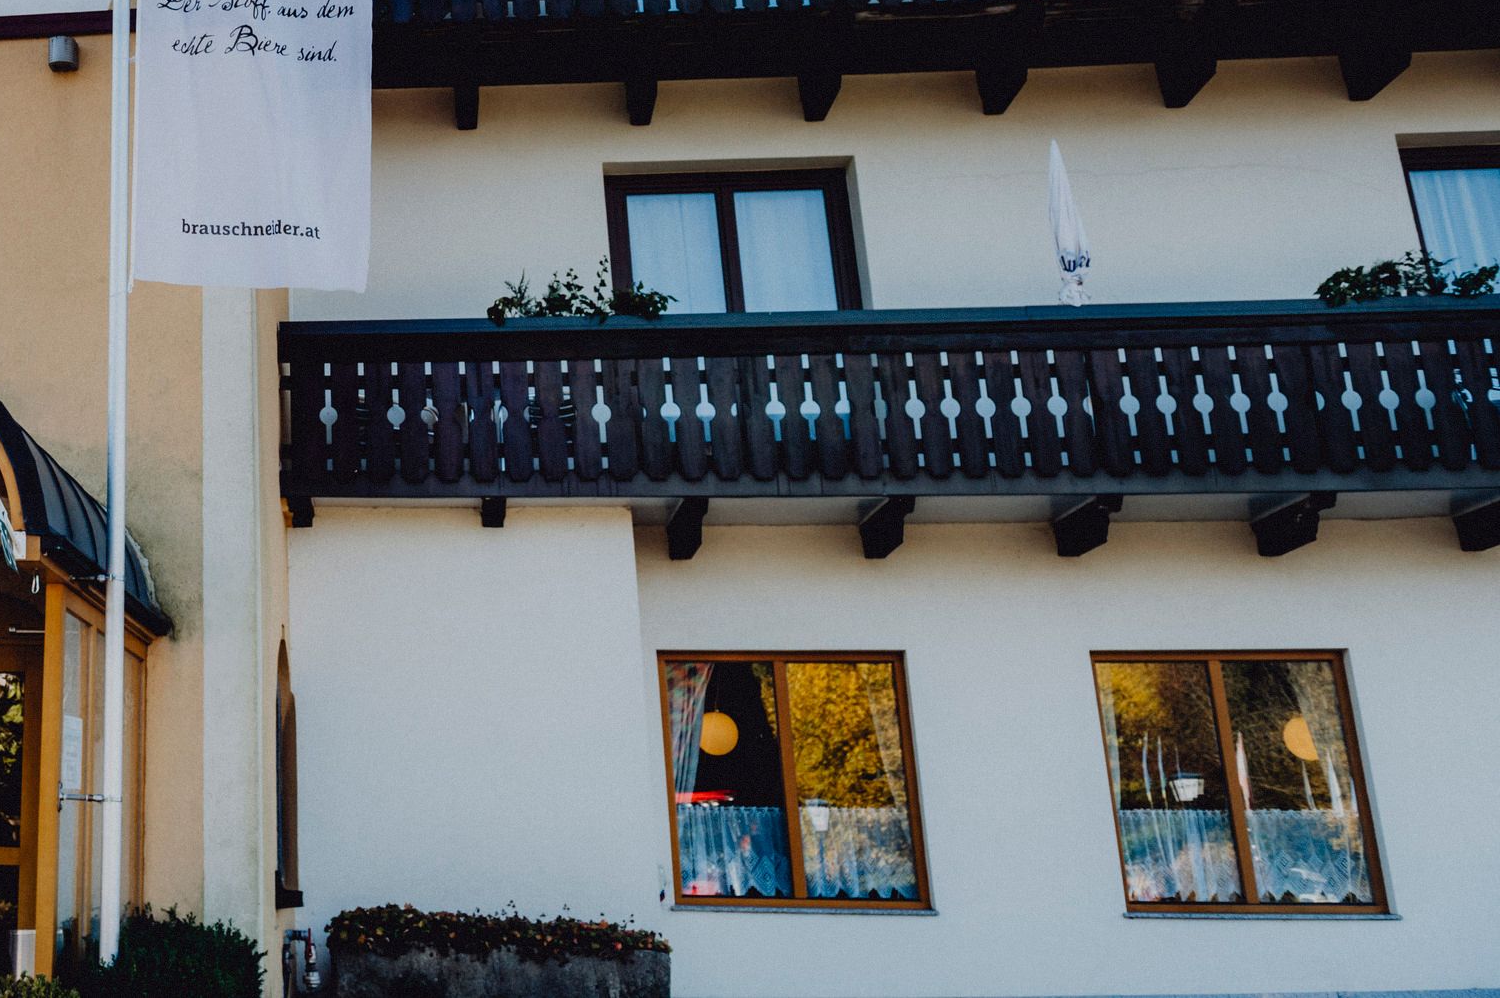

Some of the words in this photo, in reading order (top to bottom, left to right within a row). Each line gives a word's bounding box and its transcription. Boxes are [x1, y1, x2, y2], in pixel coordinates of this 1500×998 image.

[277, 6, 308, 19] aus
[172, 34, 215, 56] echte
[224, 24, 289, 56] Biere
[296, 40, 337, 62] sind.
[182, 218, 320, 240] brauschneider.at
